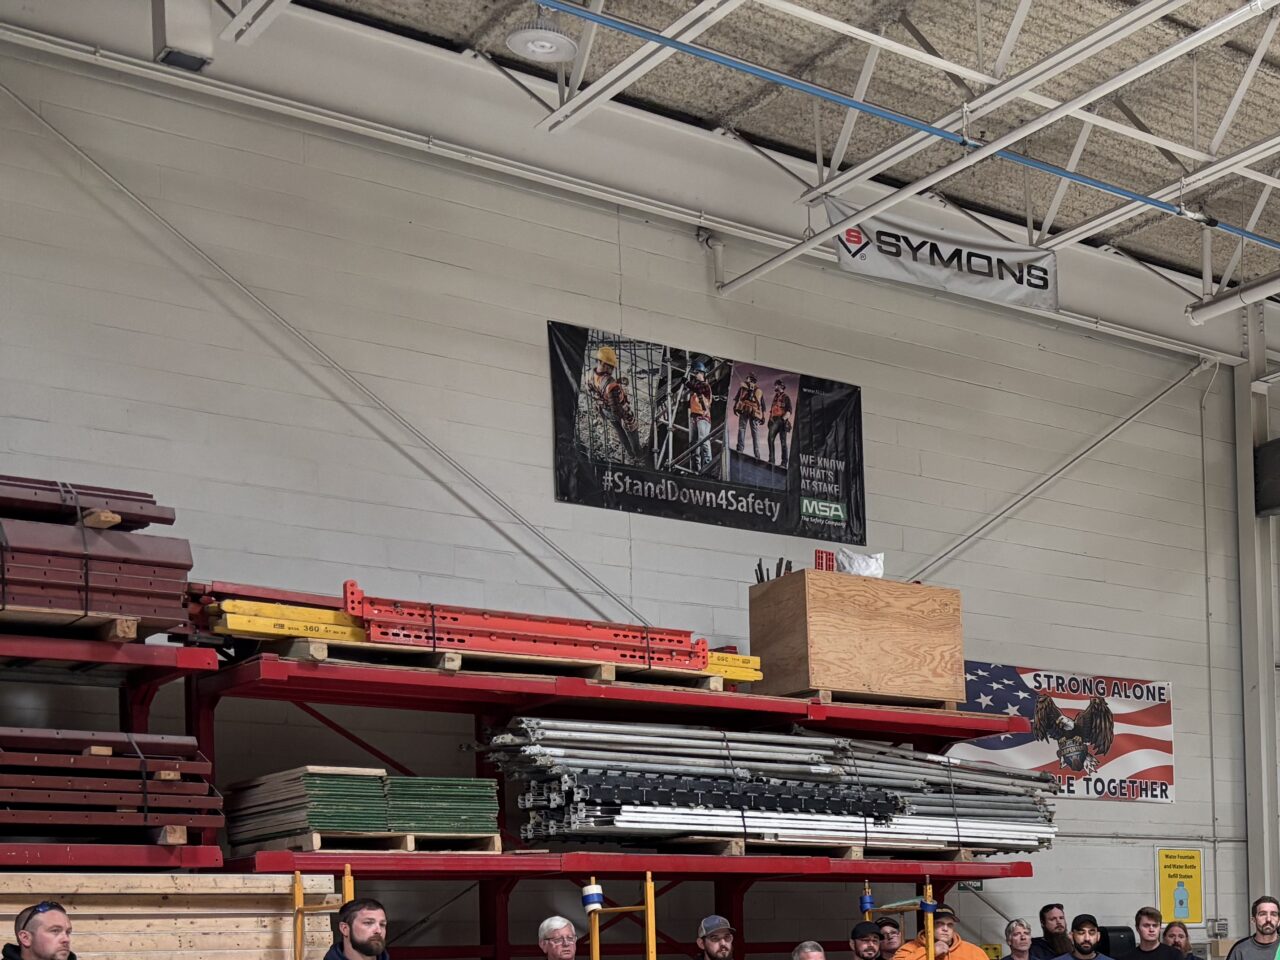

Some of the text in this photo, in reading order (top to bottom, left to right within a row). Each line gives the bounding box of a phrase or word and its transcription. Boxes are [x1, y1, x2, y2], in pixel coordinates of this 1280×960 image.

[875, 230, 1049, 290] SYMONS
[799, 453, 845, 473] WE KNOW
[800, 465, 834, 482] WHAT'S
[602, 471, 781, 522] #StandDown4Safety
[800, 479, 840, 495] AT STAKE
[802, 499, 844, 518] MSA
[810, 516, 825, 526] Safety
[303, 625, 320, 633] 360
[1032, 673, 1167, 703] STRONG ALONE
[1083, 777, 1169, 799] TOGETHER
